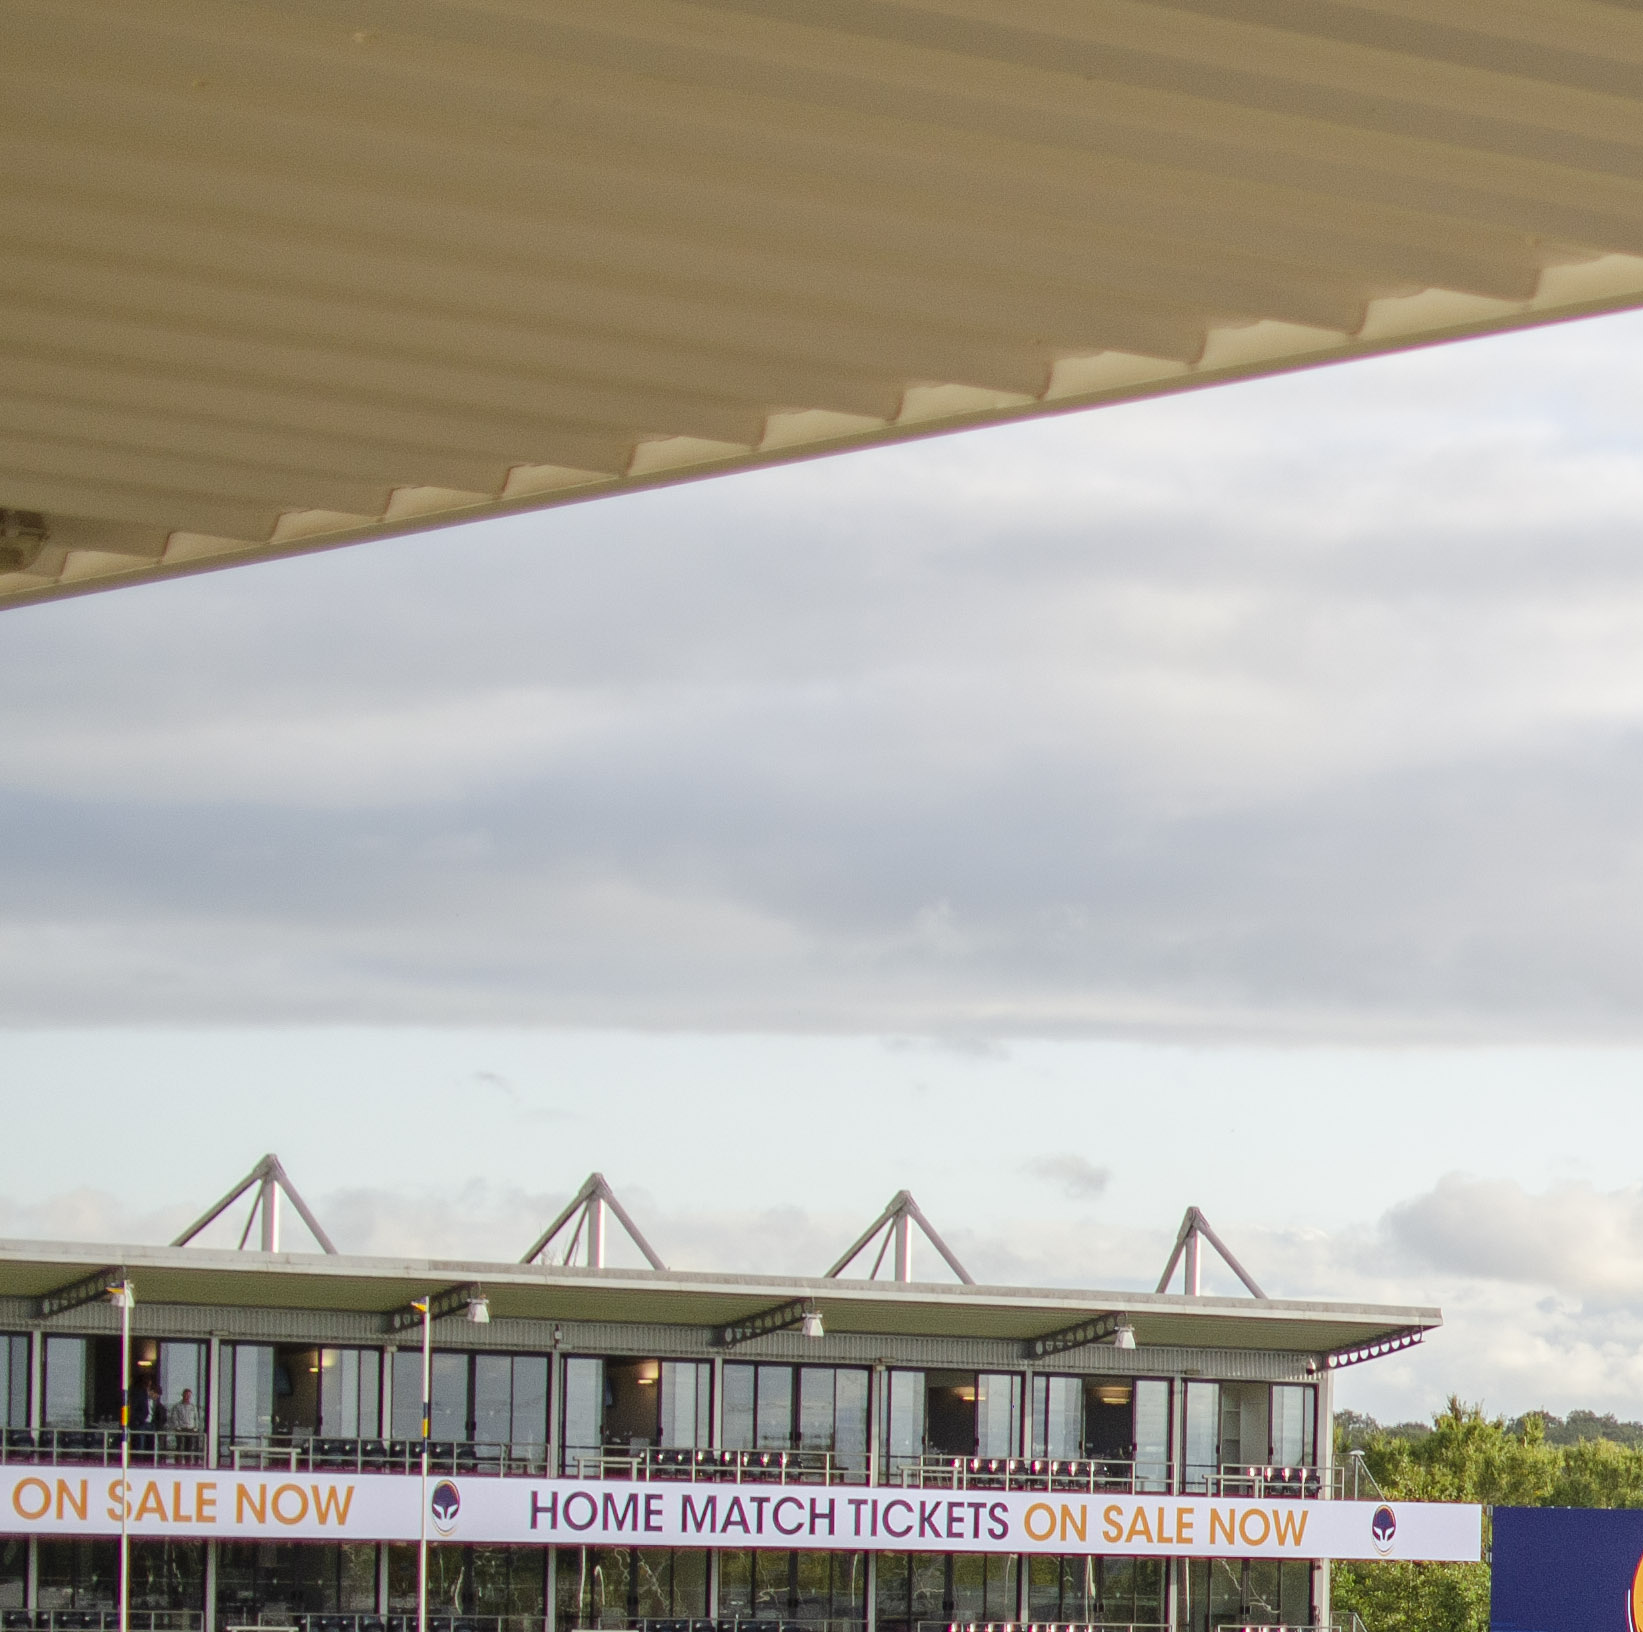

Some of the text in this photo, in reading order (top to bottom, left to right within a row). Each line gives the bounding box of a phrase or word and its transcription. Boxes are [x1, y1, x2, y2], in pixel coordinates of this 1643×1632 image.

[12, 1477, 355, 1526] ON SALE NOW
[530, 1490, 1309, 1547] HOME MATCH TICKETS ON SALE NOW
